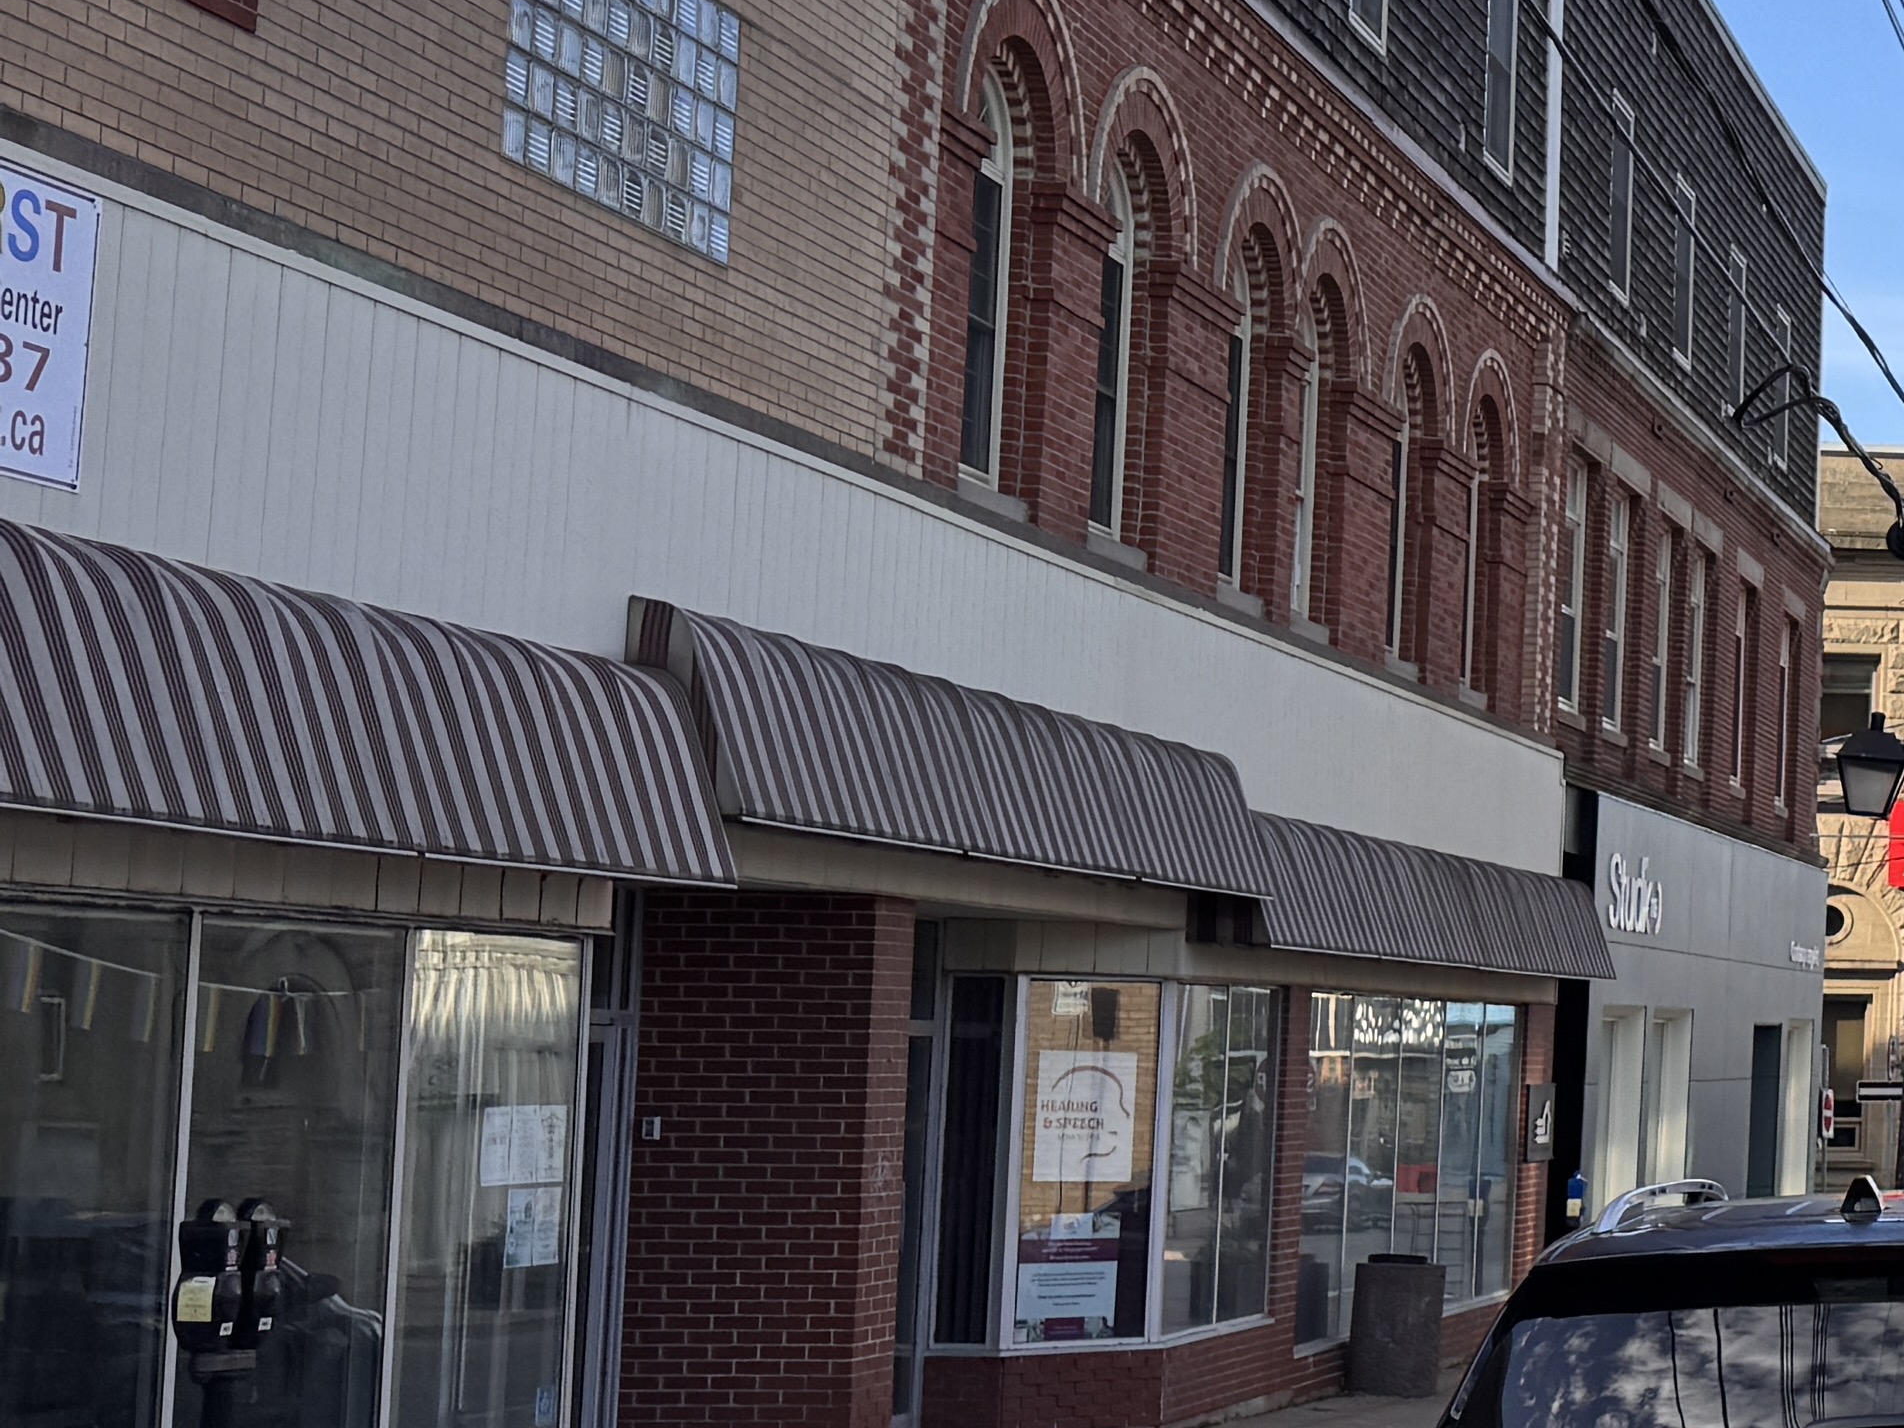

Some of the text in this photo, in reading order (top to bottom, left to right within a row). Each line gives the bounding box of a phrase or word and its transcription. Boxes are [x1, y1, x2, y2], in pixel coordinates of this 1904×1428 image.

[0, 180, 77, 273] ST
[0, 286, 63, 336] enter
[0, 409, 45, 457] .ca
